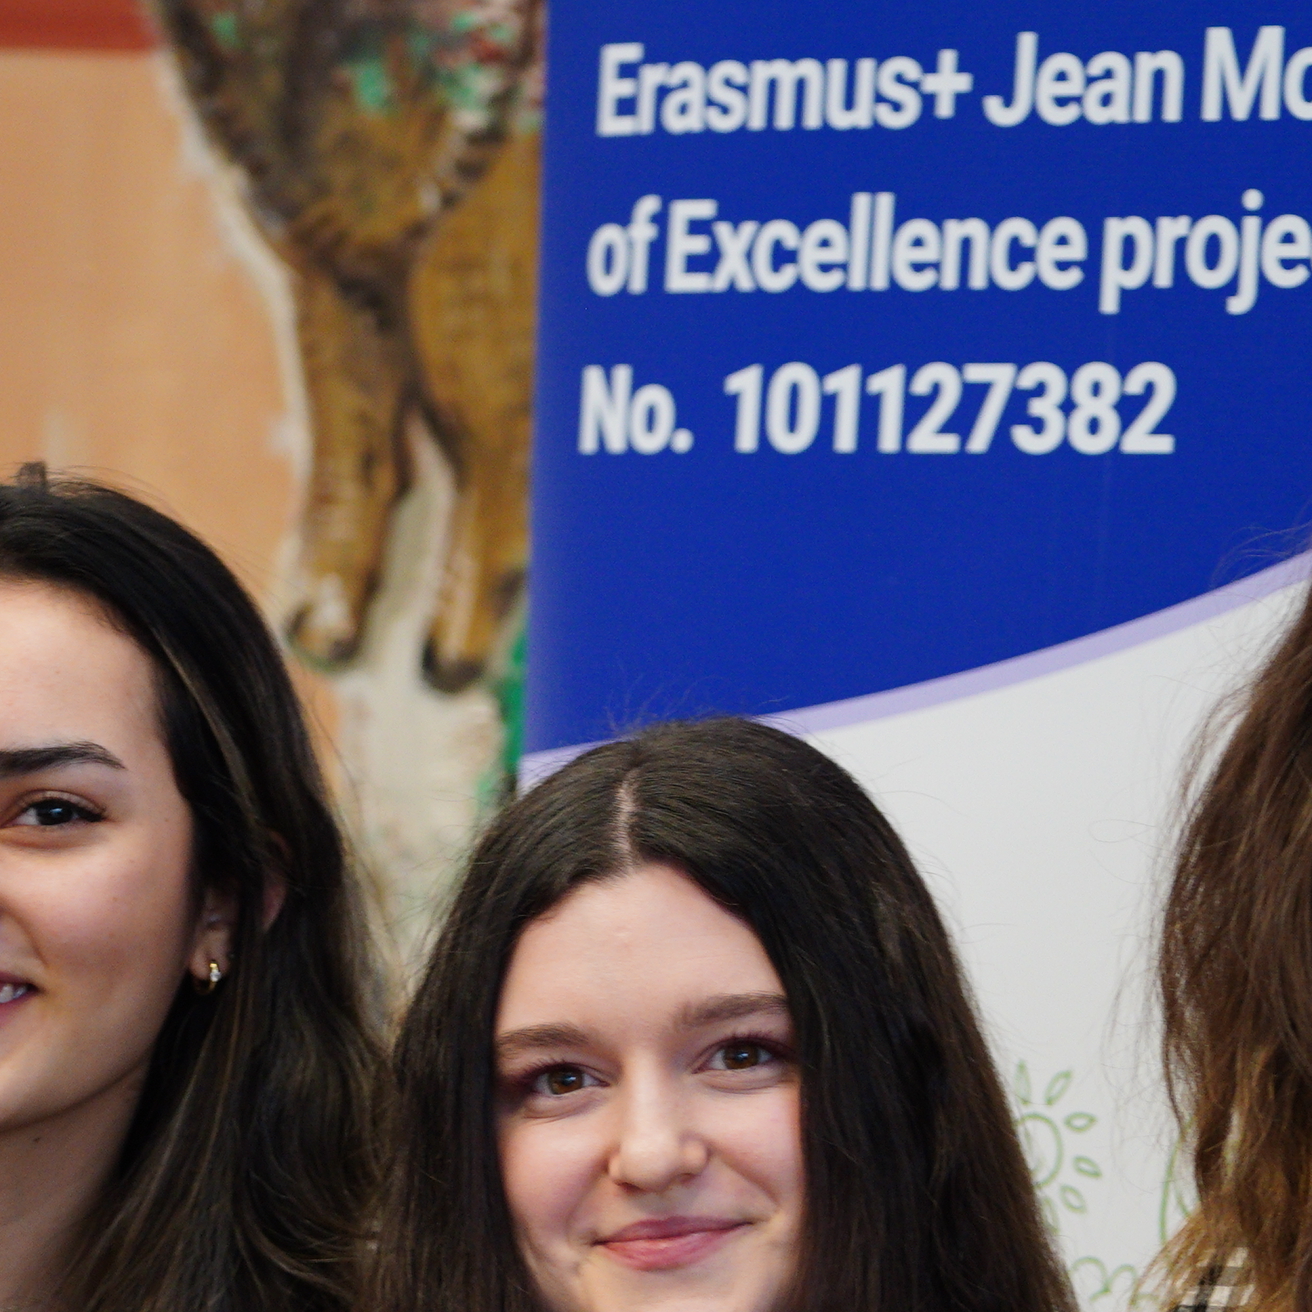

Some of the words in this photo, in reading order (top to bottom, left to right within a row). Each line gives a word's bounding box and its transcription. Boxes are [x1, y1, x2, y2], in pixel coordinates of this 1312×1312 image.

[596, 42, 972, 137] Erasmus+
[982, 31, 1184, 127] Jean
[587, 194, 664, 296] of
[665, 191, 1087, 294] Excellence
[579, 363, 693, 454] No.
[724, 361, 1176, 455] 101127382
